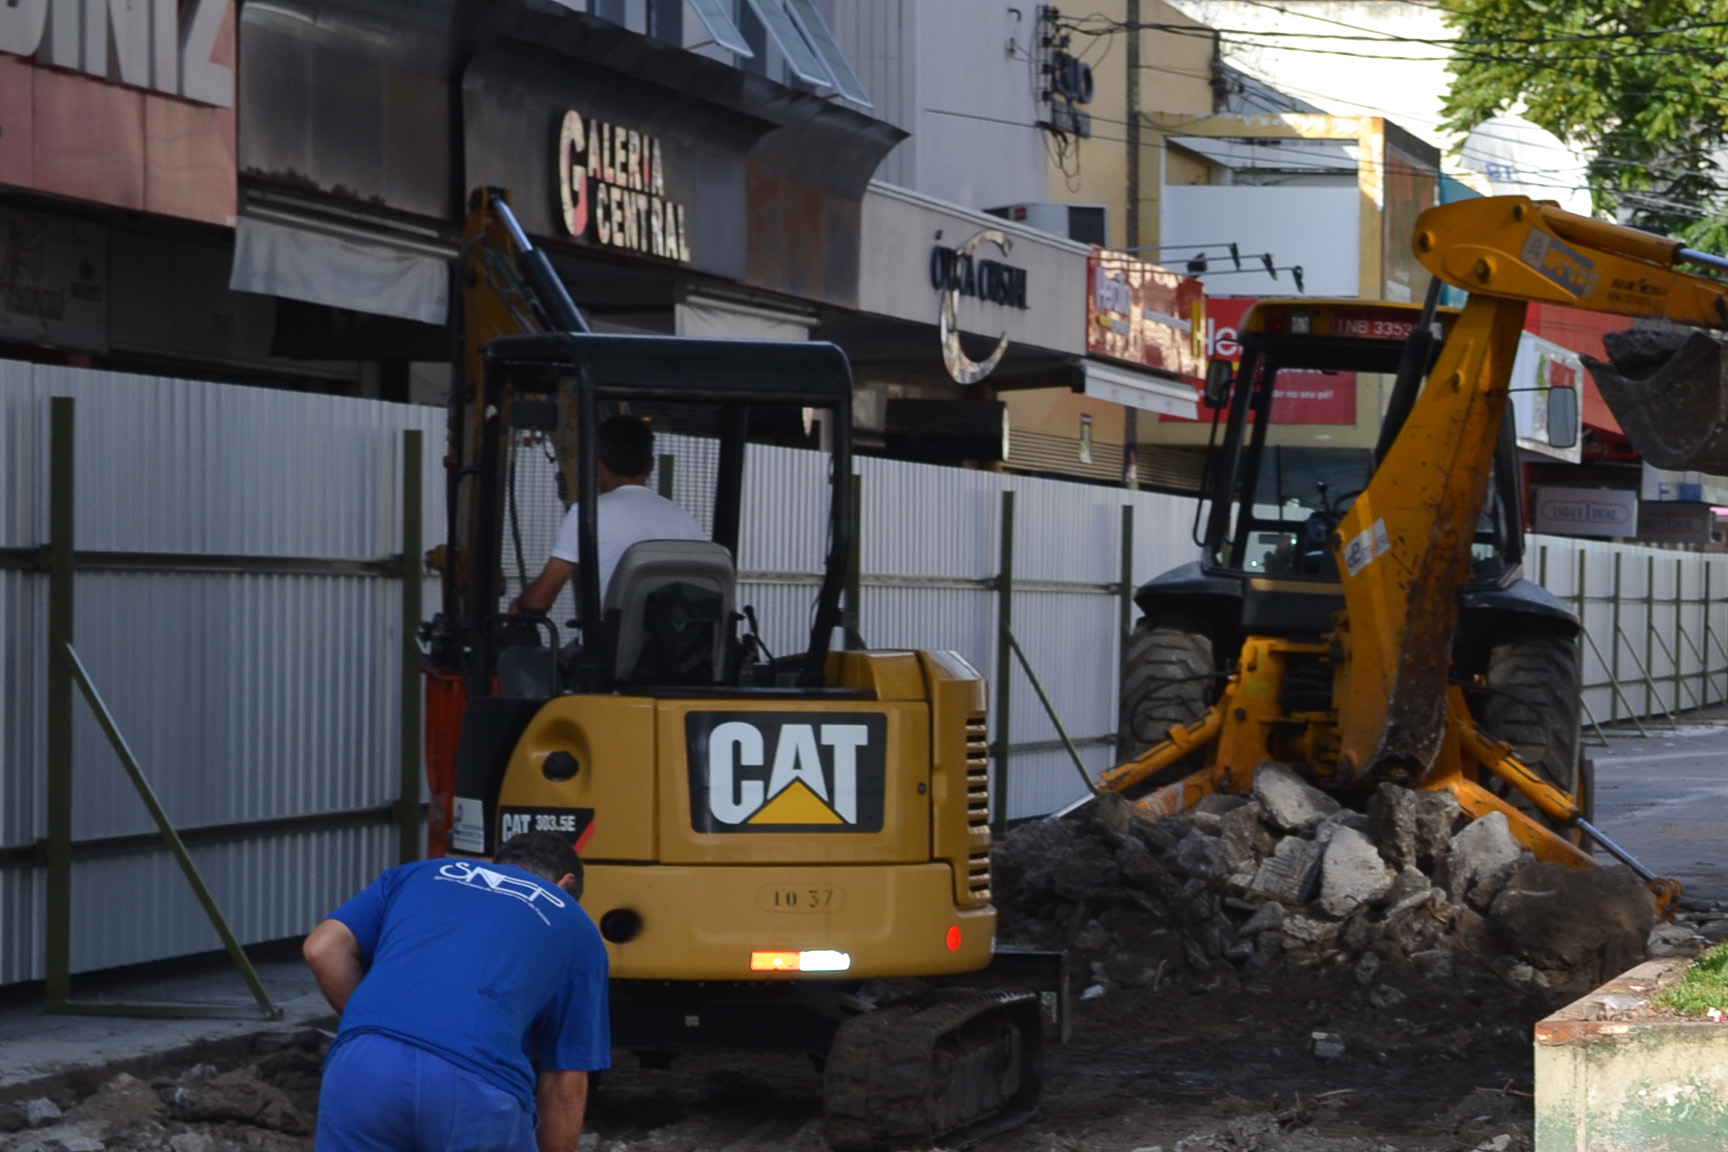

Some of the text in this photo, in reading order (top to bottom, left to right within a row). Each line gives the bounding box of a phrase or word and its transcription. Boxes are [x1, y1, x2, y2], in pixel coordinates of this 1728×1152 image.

[559, 109, 665, 238] GALERIA
[596, 182, 691, 263] CENTRAL
[708, 721, 869, 825] CAT
[502, 813, 532, 843] CAT
